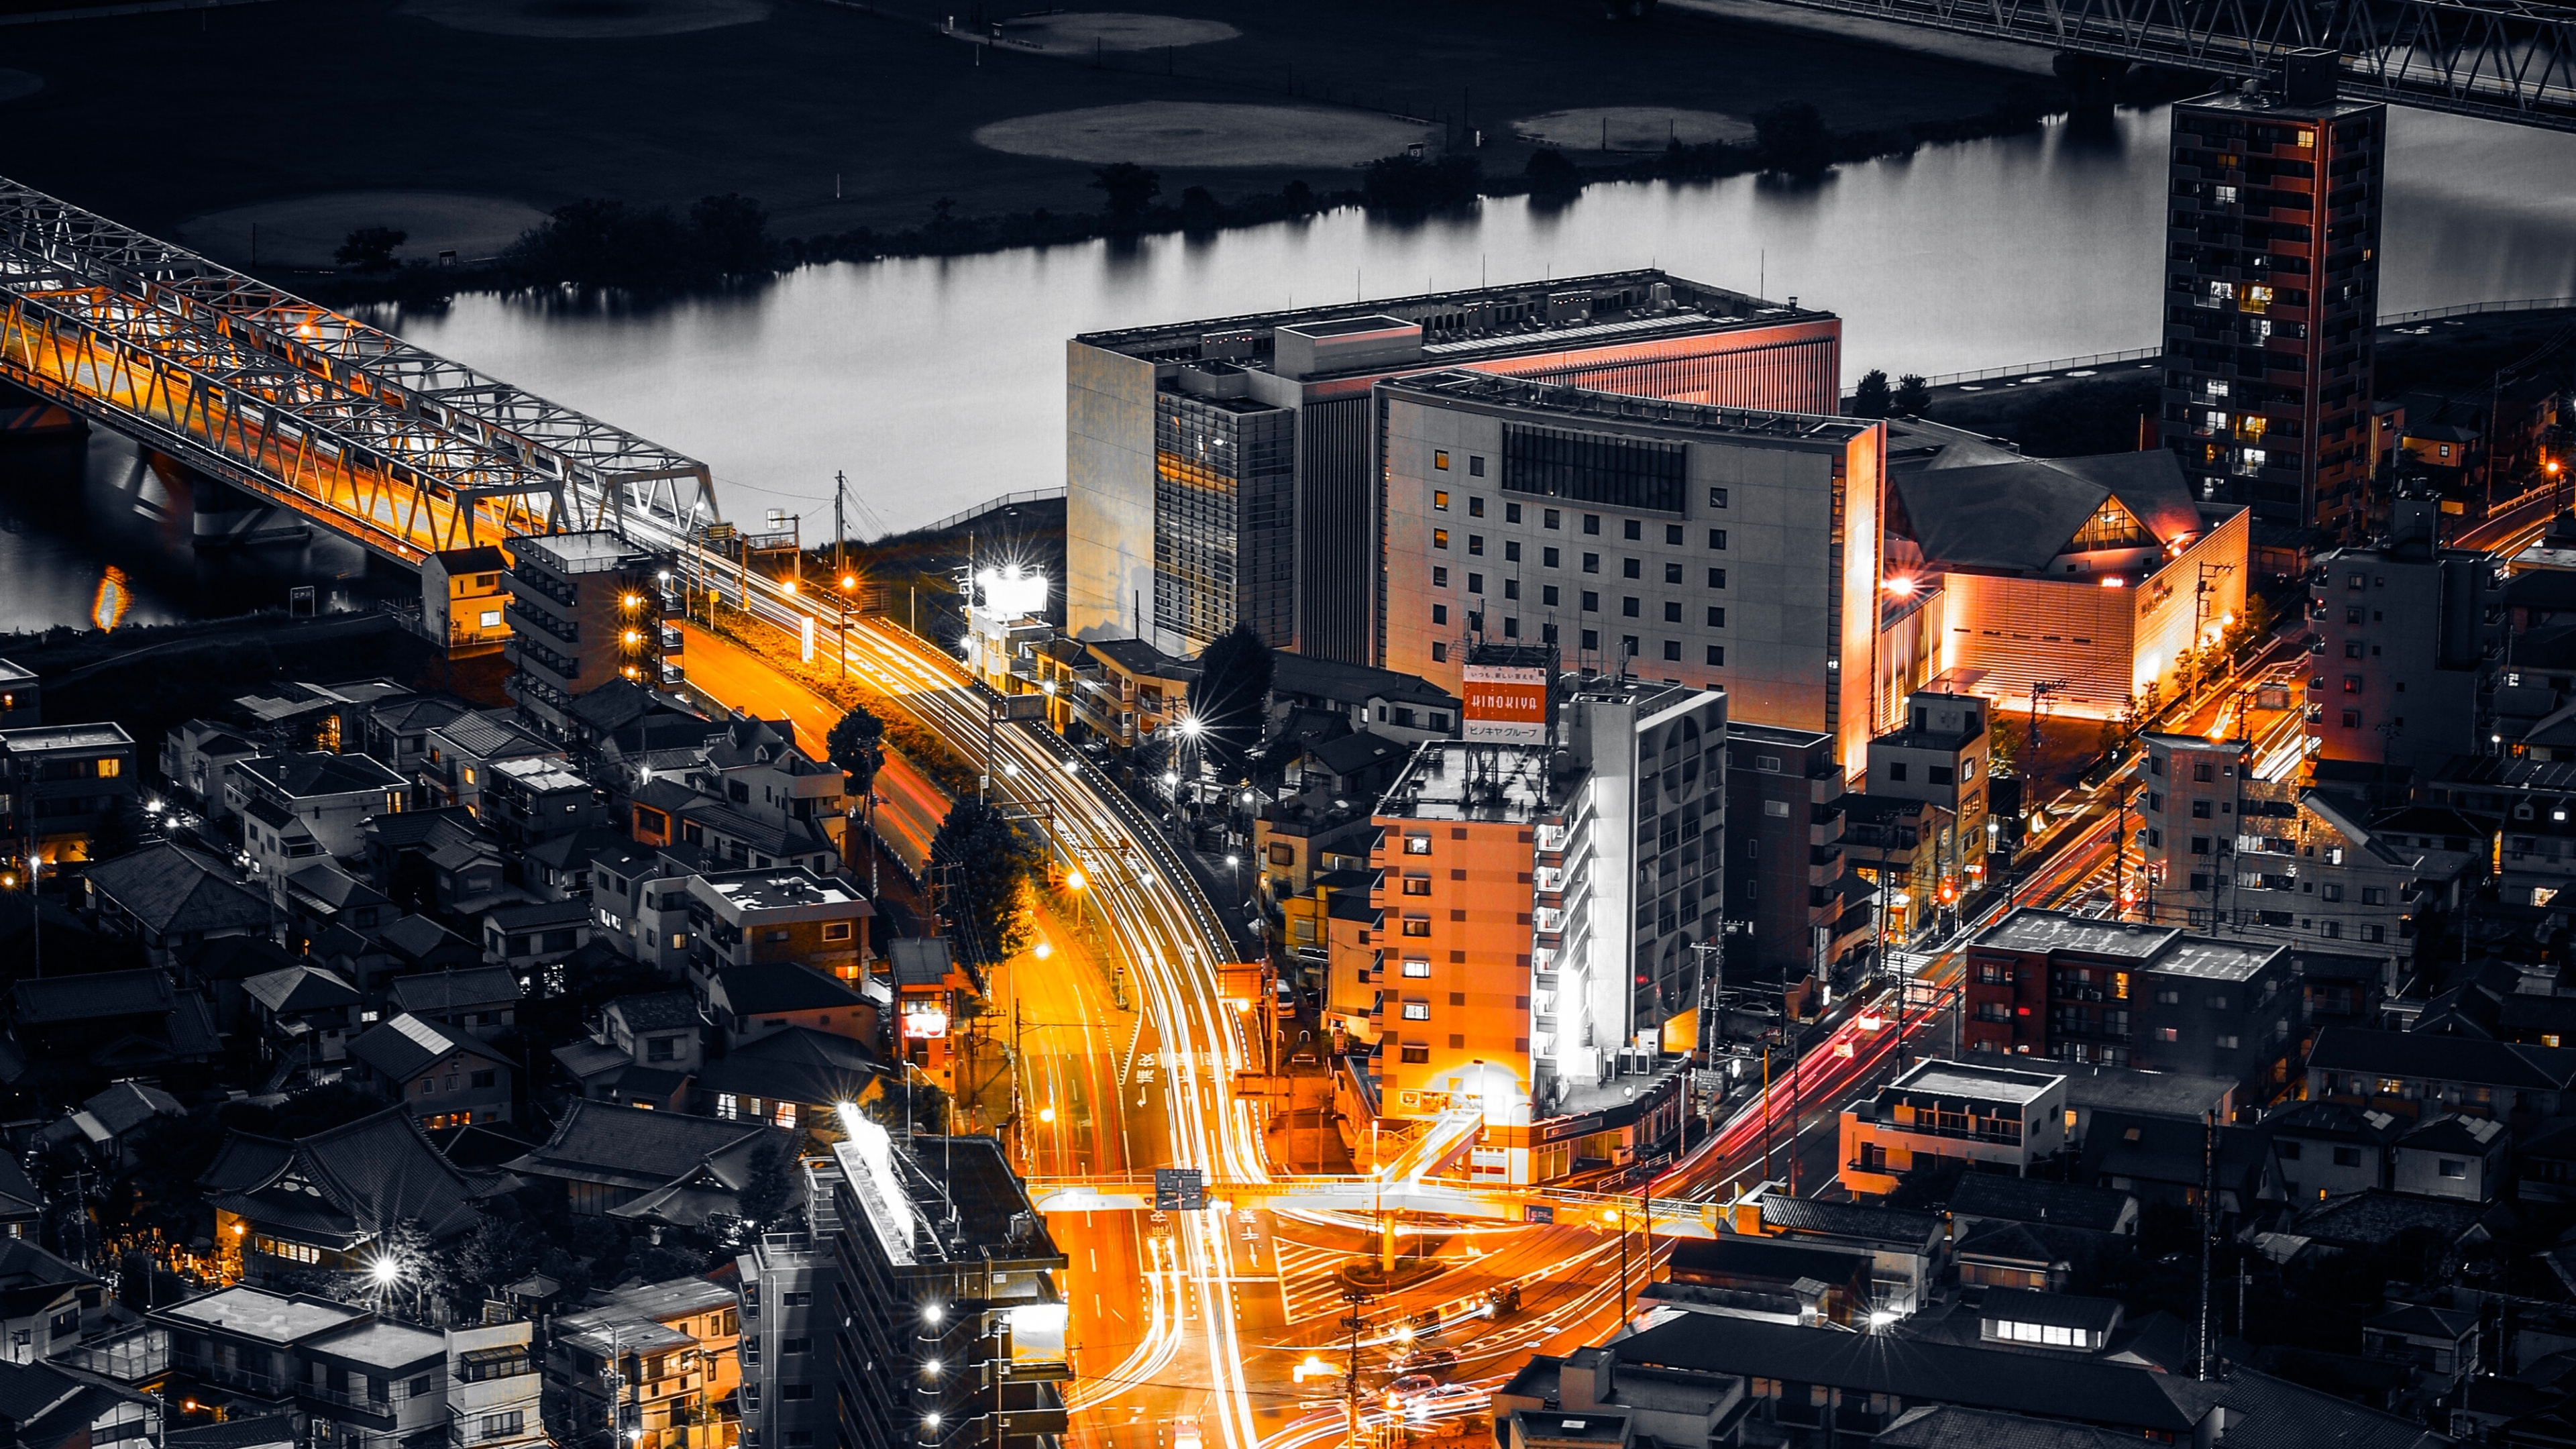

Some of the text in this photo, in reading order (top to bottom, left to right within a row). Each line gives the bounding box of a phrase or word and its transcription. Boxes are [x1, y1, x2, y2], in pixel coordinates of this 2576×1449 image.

[1471, 695, 1537, 710] HINOKIYA
[1136, 1053, 1155, 1084] 浦安
[1238, 1209, 1260, 1240] 千葉
